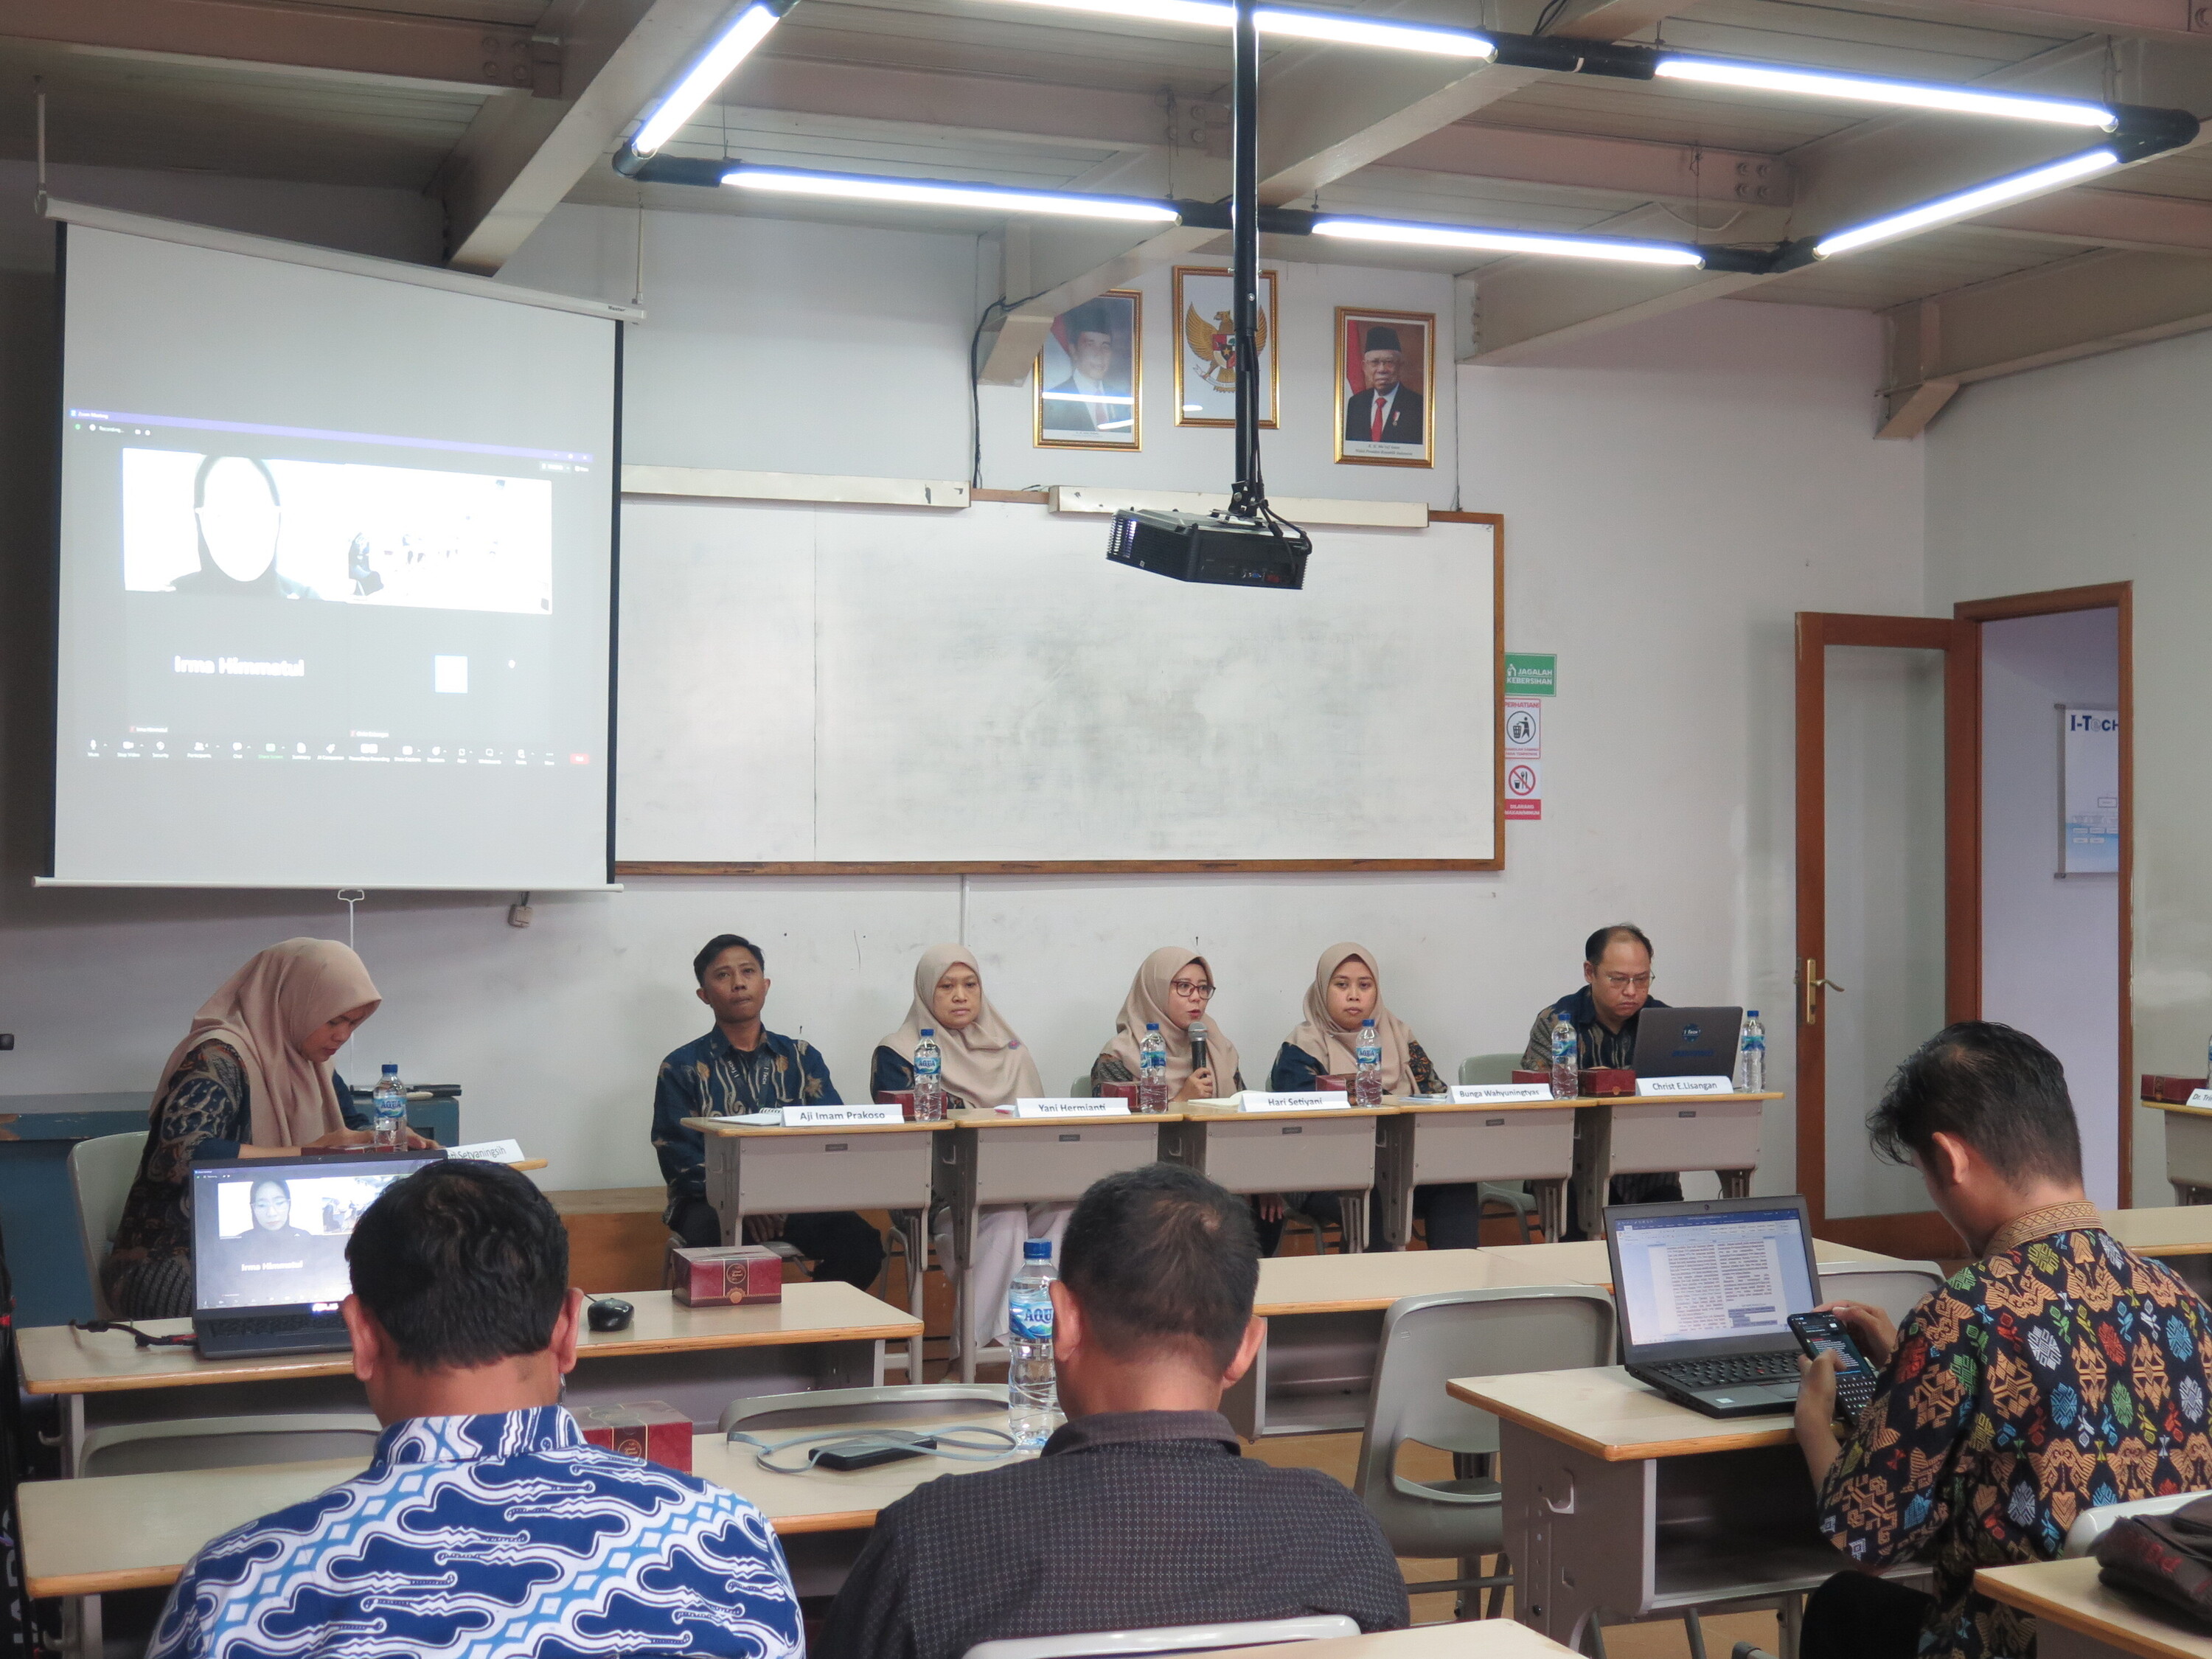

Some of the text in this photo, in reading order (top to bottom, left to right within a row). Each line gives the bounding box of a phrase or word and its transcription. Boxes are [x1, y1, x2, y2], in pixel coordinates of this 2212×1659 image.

[1506, 677, 1552, 685] KEBERSIHAN
[1652, 1082, 1717, 1091] Christ E.Lisangan
[1484, 1089, 1540, 1097] Wahyuningtyas
[381, 1100, 401, 1109] AQUA
[1268, 1097, 1323, 1106] Hari Setiyani
[1038, 1103, 1106, 1112] Yani Hermianti
[800, 1110, 885, 1121] Aji Imam Prakoso
[1024, 1308, 1053, 1324] AQU
